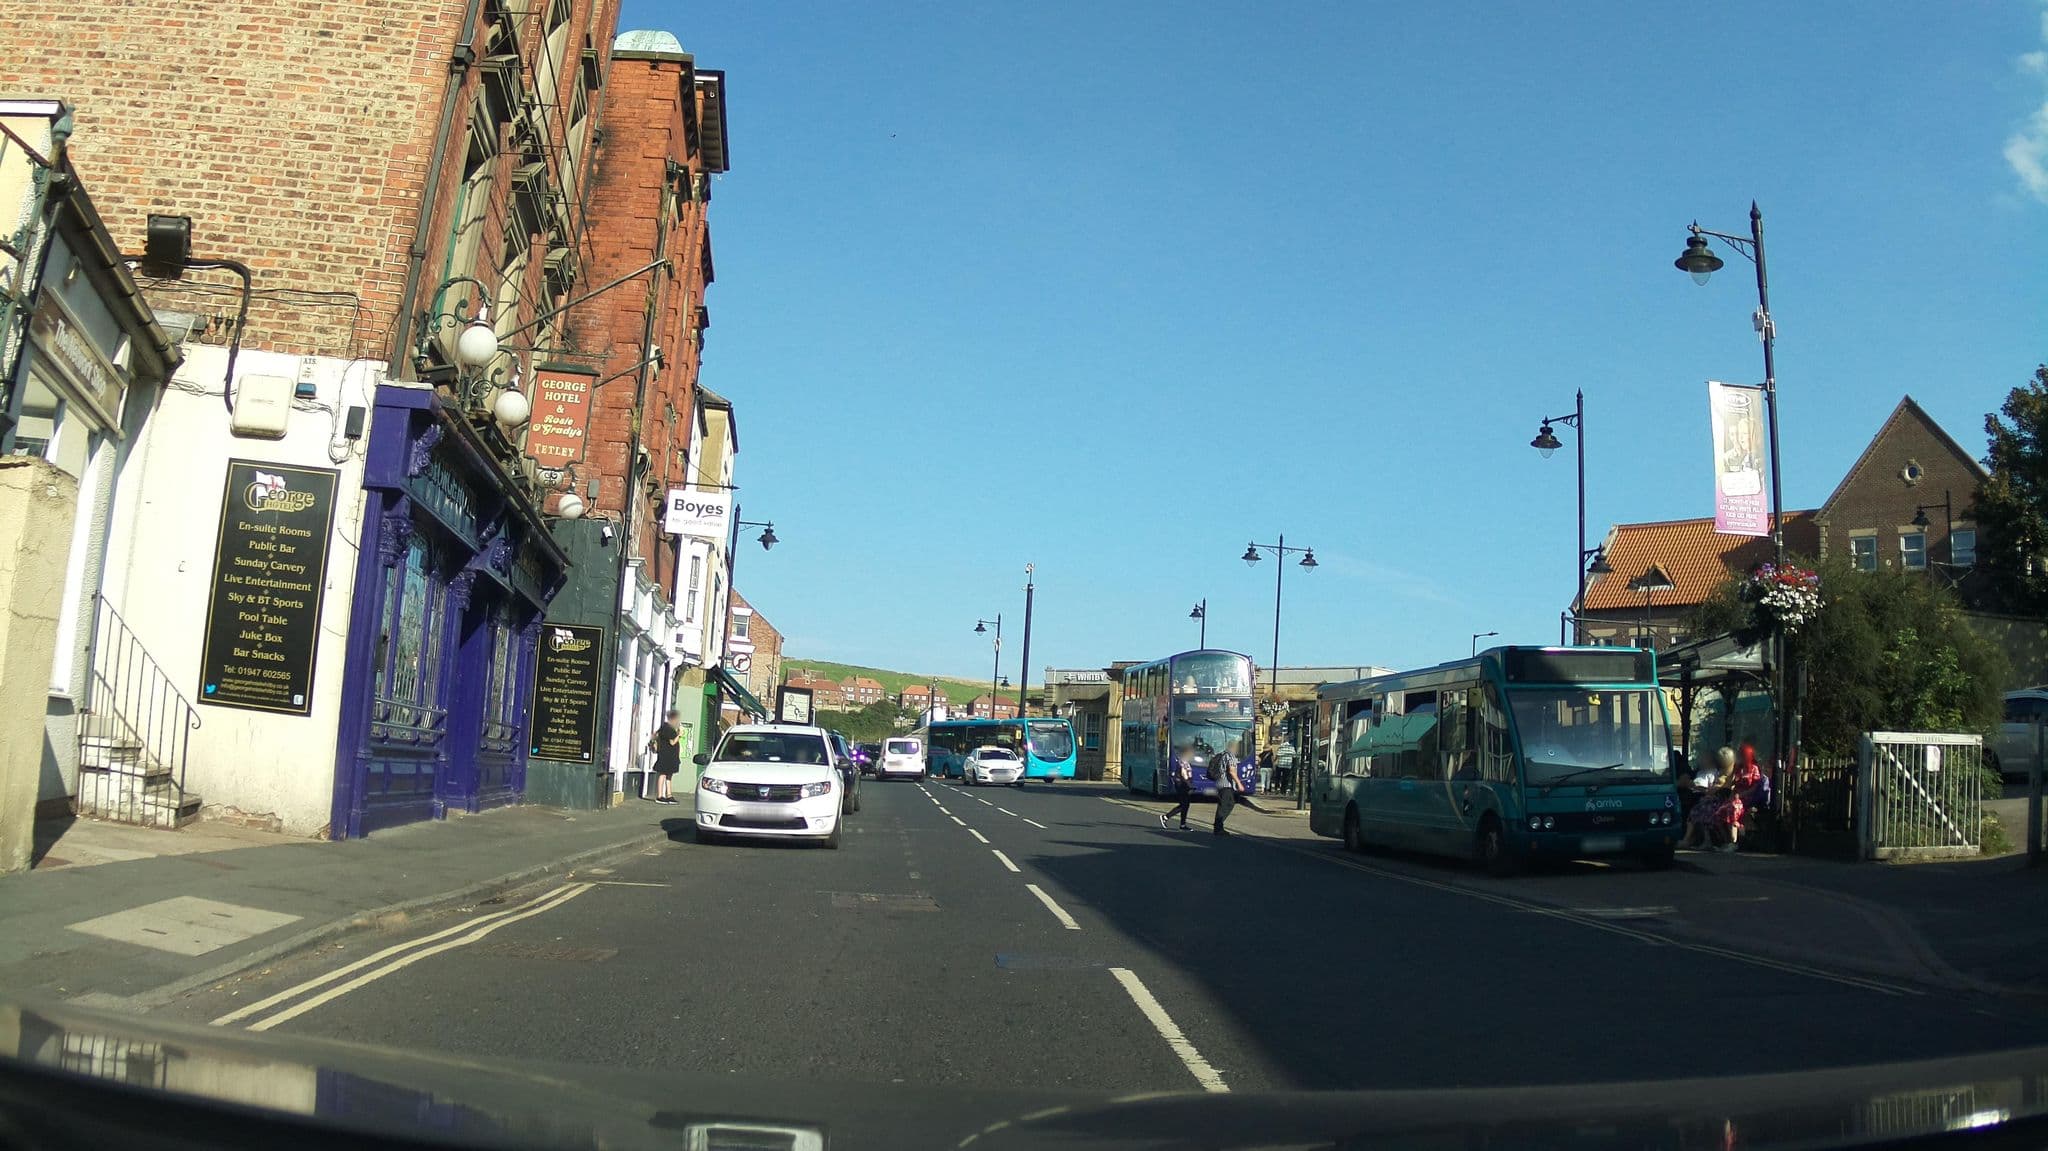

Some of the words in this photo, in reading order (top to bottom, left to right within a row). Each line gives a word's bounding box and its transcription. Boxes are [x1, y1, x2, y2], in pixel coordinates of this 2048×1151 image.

[542, 380, 586, 392] GEORGE
[544, 391, 580, 403] HOTEL
[556, 404, 565, 413] &
[544, 415, 573, 425] Rosie
[534, 443, 575, 457] TETLEY
[243, 481, 315, 511] George
[264, 500, 294, 511] HOTEL
[674, 498, 723, 518] Boyes
[239, 521, 277, 534] En-suite
[279, 526, 312, 538] Rooms
[249, 541, 277, 552] Public
[280, 544, 296, 554] Bar
[234, 557, 268, 570] Sunday
[271, 561, 305, 574] Carvery
[224, 573, 243, 583] Live
[245, 576, 312, 592] Entertainment
[228, 592, 244, 604] Sky
[246, 594, 256, 603] &
[258, 595, 271, 605] BT
[273, 597, 304, 609] Sports
[239, 612, 259, 622] Pool
[262, 614, 288, 625] Table
[239, 630, 262, 641] Juke
[265, 633, 283, 643] Box
[233, 648, 250, 657] Bar
[252, 649, 285, 662] Snacks
[224, 664, 237, 674] Tel:
[238, 667, 262, 676] 01947
[1077, 672, 1105, 681] WHITBY
[1596, 798, 1623, 808] arriva
